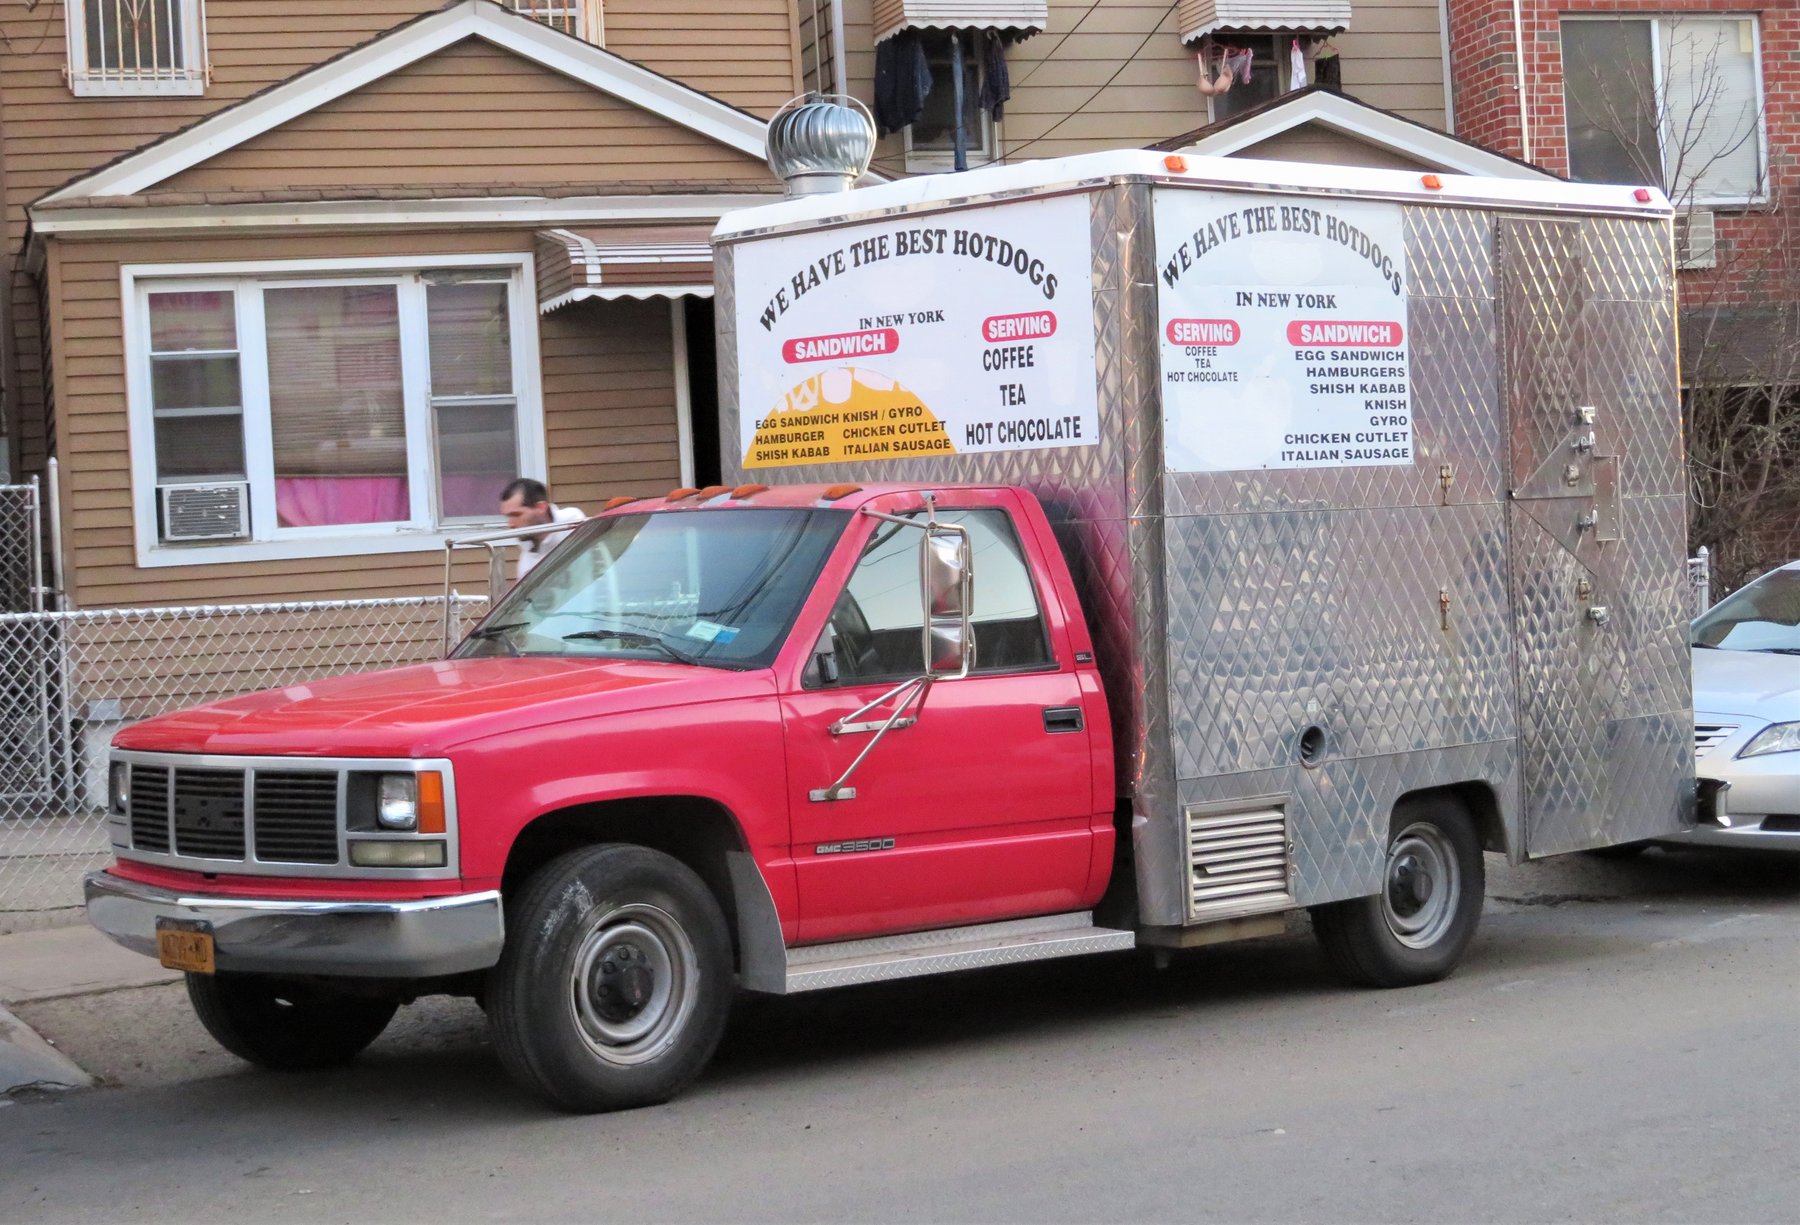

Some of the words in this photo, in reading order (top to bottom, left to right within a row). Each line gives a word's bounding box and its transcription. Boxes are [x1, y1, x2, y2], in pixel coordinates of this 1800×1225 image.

[1162, 242, 1192, 290] WE
[1192, 212, 1241, 259] HAVE
[1243, 206, 1277, 234] THE
[1280, 206, 1321, 236] BEST
[1326, 214, 1402, 296] HOTDOGS
[759, 287, 790, 332] WE
[791, 250, 846, 300] HAVE
[850, 235, 890, 267] THE
[895, 229, 947, 257] BEST
[953, 230, 1058, 300] HOTDOGS
[1236, 292, 1253, 307] IN
[1257, 292, 1291, 308] NEW
[1295, 293, 1337, 309] YORK
[859, 318, 873, 330] IN
[876, 314, 905, 327] NEW
[908, 310, 945, 325] YORK
[988, 314, 1051, 339] SERVING
[1173, 322, 1233, 342] SERVING
[1300, 324, 1391, 343] SANDWICH
[795, 333, 886, 359] SANDWICH
[1185, 346, 1217, 357] COFFEE
[983, 345, 1034, 371] COFFEE
[1195, 359, 1211, 368] TEA
[1295, 350, 1326, 361] EGG
[1330, 351, 1405, 361] SANDWICH
[1167, 372, 1185, 382] HOT
[1187, 371, 1238, 382] CHOCOLATE
[1306, 367, 1405, 378] HAMBURGERS
[1000, 384, 1026, 406] TEA
[1310, 384, 1355, 394] SHISH
[1359, 383, 1406, 394] KABAB
[1364, 400, 1407, 410] KNISH
[755, 418, 777, 430] EGG
[780, 413, 839, 428] SANDWICH
[843, 409, 878, 423] KNISH
[888, 406, 923, 419] GYRO
[1370, 415, 1408, 426] GYRO
[755, 430, 825, 445] HAMBURGER
[843, 425, 895, 439] CHICKEN
[899, 420, 946, 435] CUTLET
[966, 423, 994, 445] HOT
[998, 416, 1082, 444] CHOCOLATE
[844, 442, 889, 455] ITALIAN
[893, 438, 950, 452] SAUSAGE
[1284, 433, 1350, 445] CHICKEN
[1355, 432, 1408, 443] CUTLET
[756, 449, 788, 461] SHISH
[792, 446, 830, 458] KABAB
[1281, 450, 1339, 461] ITALIAN
[1344, 448, 1409, 460] SAUSAGE
